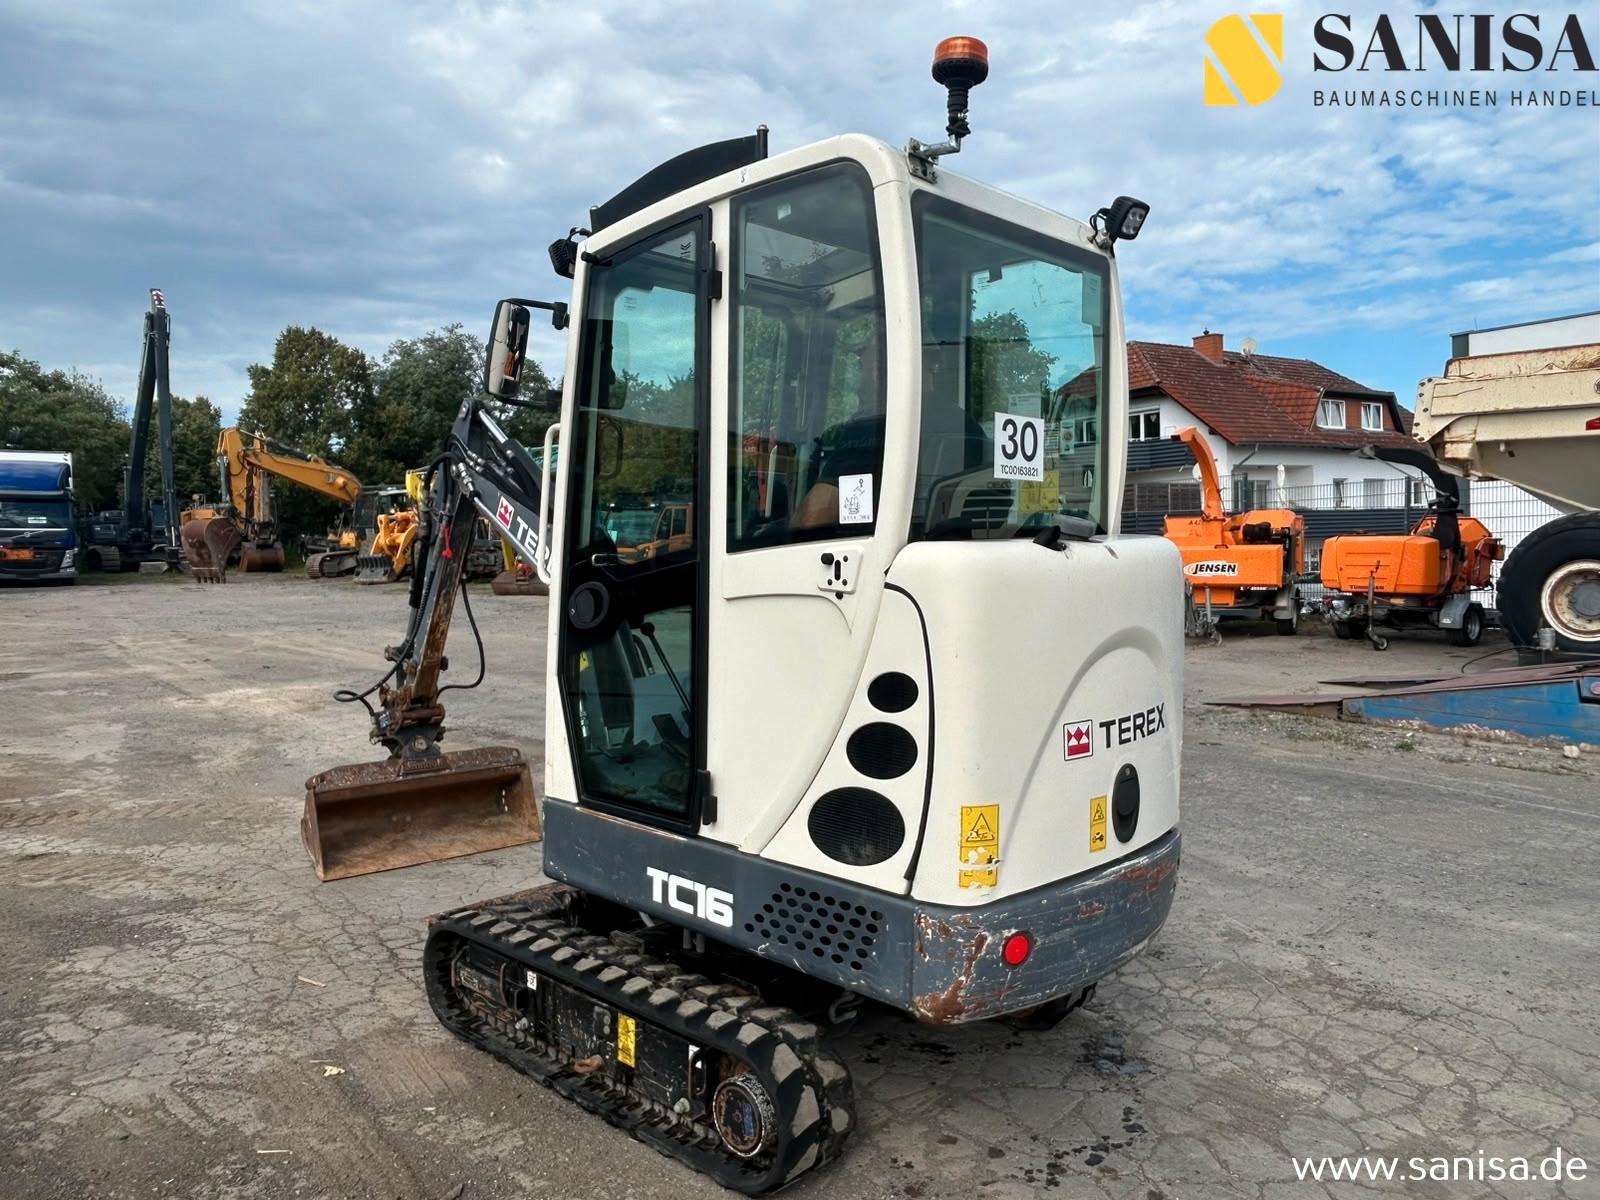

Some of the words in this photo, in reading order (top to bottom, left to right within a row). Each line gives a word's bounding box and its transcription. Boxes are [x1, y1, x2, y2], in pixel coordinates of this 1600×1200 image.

[1001, 418, 1038, 462] 30
[1192, 563, 1236, 575] JENSEN
[1099, 702, 1165, 748] TEREX
[646, 866, 734, 928] TC16
